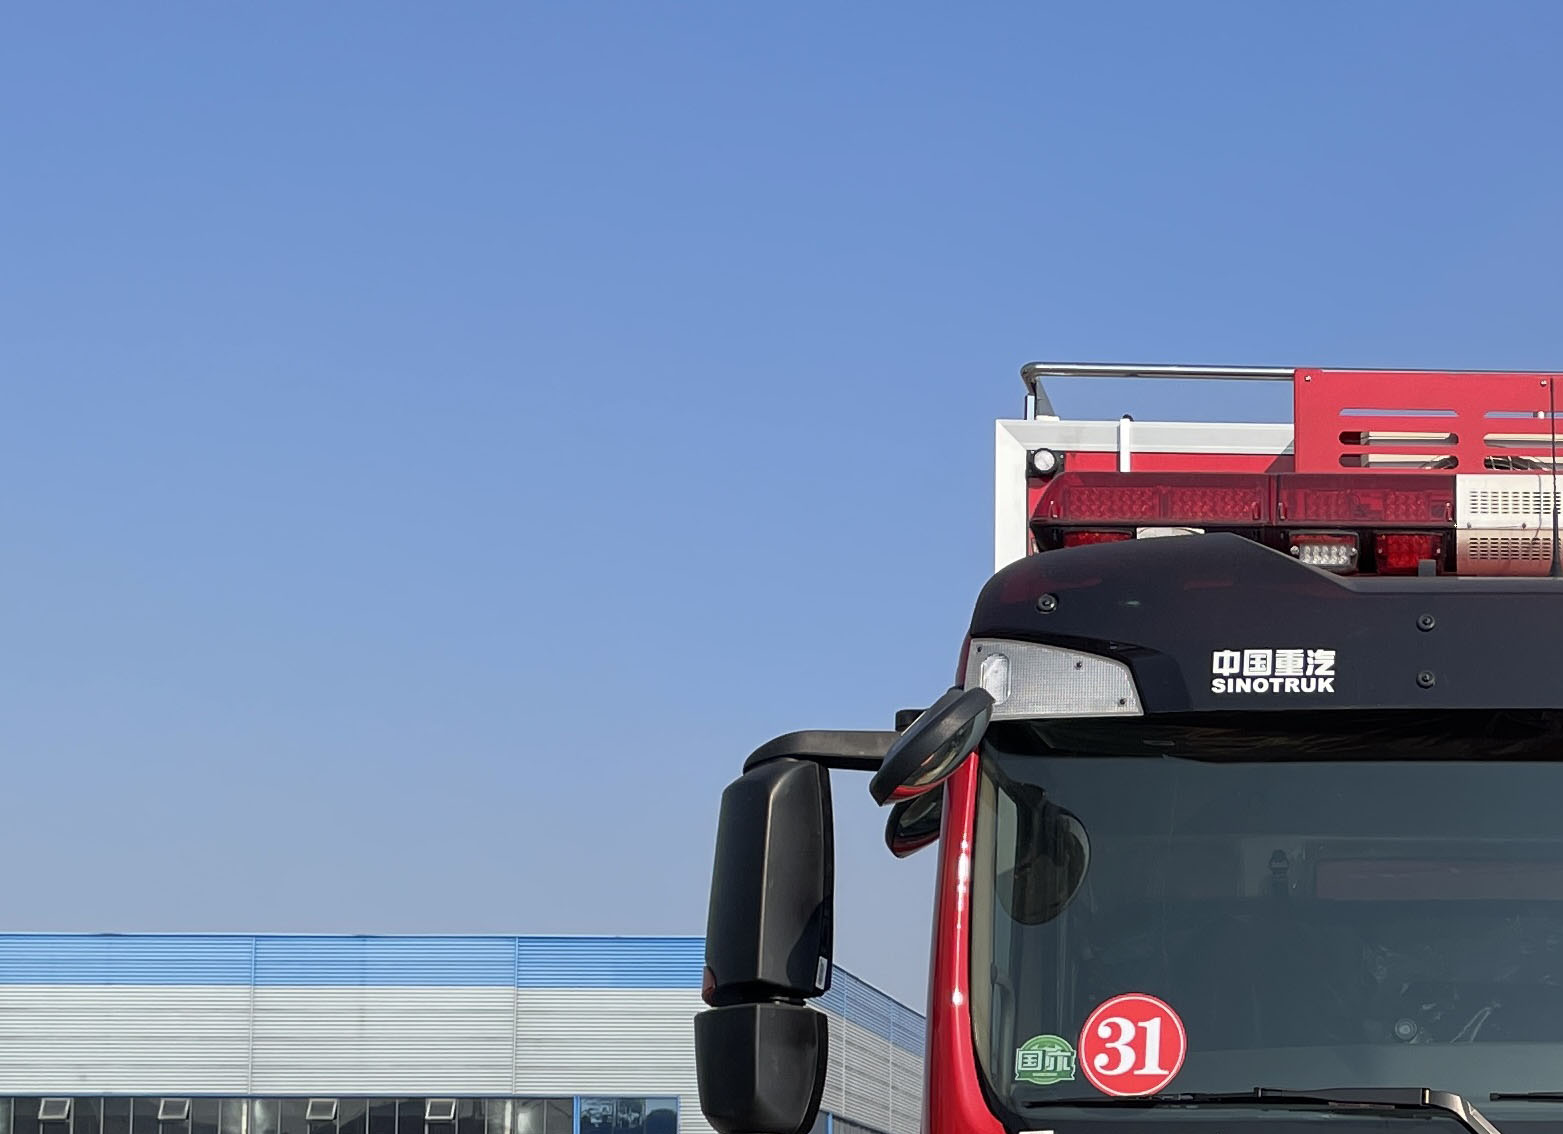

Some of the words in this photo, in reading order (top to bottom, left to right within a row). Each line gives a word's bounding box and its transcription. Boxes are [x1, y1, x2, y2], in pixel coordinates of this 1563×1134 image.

[1211, 648, 1336, 677] 中国重汽
[1211, 677, 1335, 693] SINOTRUK
[1093, 1016, 1170, 1076] 31
